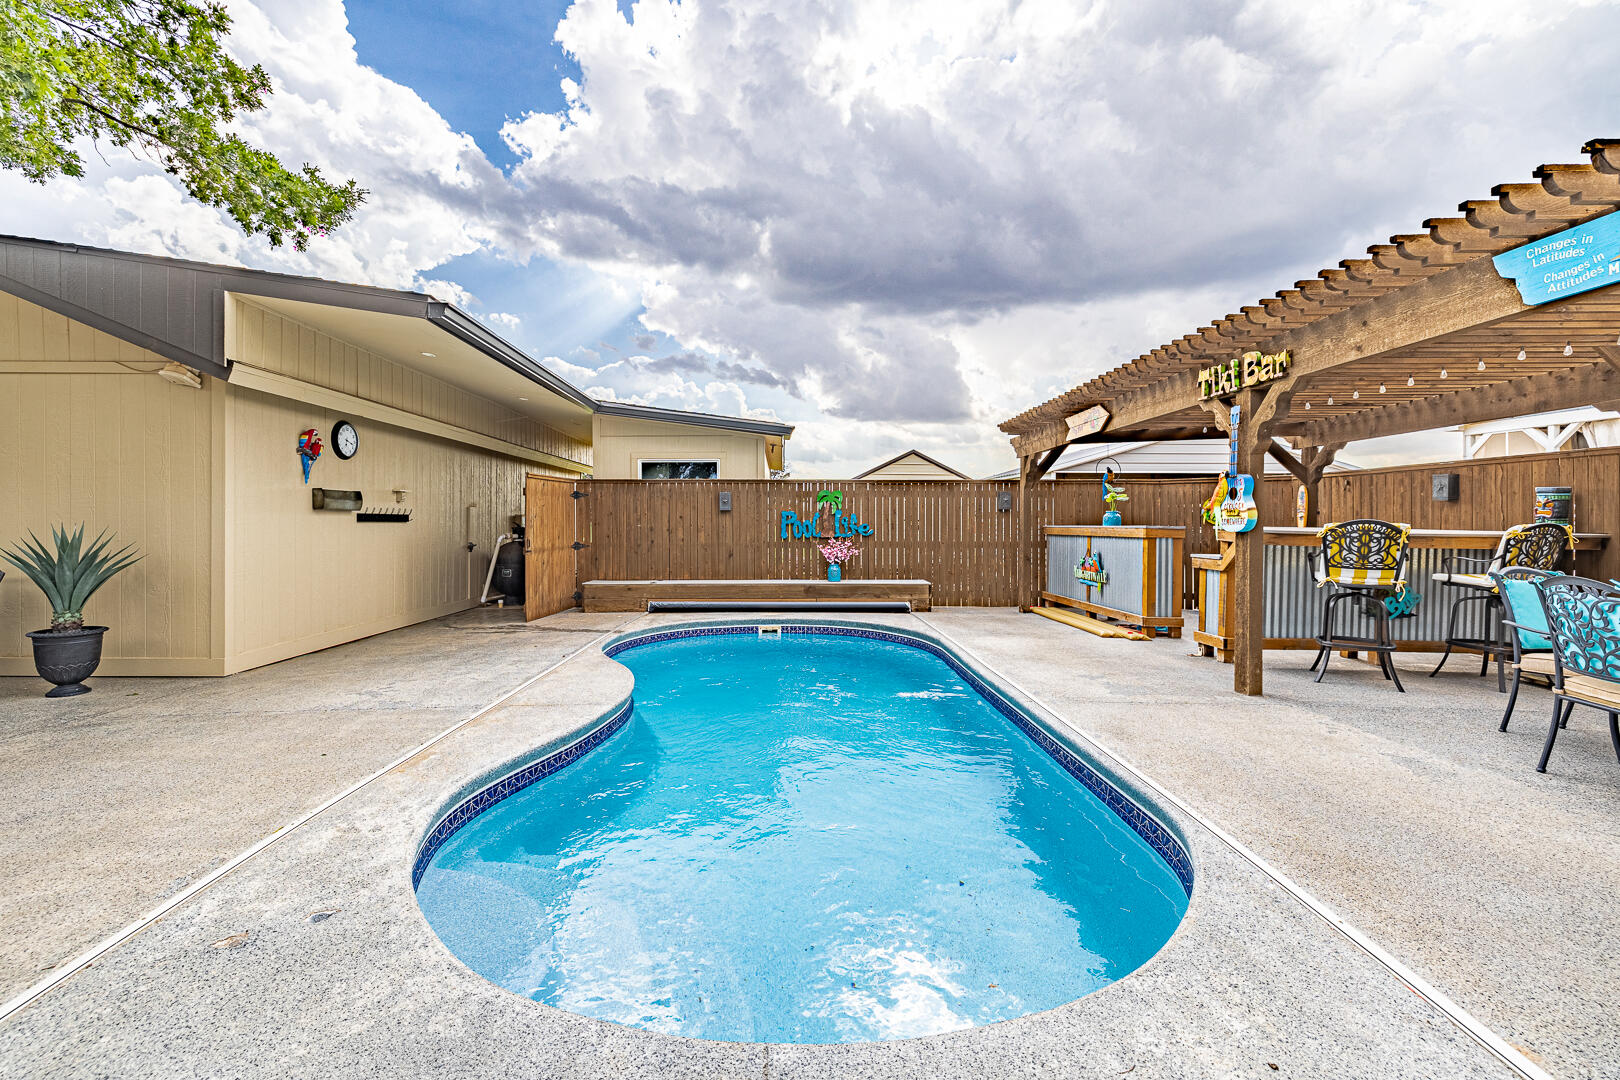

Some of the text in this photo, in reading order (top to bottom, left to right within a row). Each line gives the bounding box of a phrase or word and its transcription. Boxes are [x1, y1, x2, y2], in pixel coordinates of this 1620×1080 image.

[1526, 234, 1594, 259] Changes in
[1532, 247, 1586, 268] Latitudes
[1543, 252, 1605, 283] Changes in
[1547, 265, 1604, 294] Attitudes
[1241, 349, 1292, 388] Bar
[780, 509, 874, 539] Pool Life
